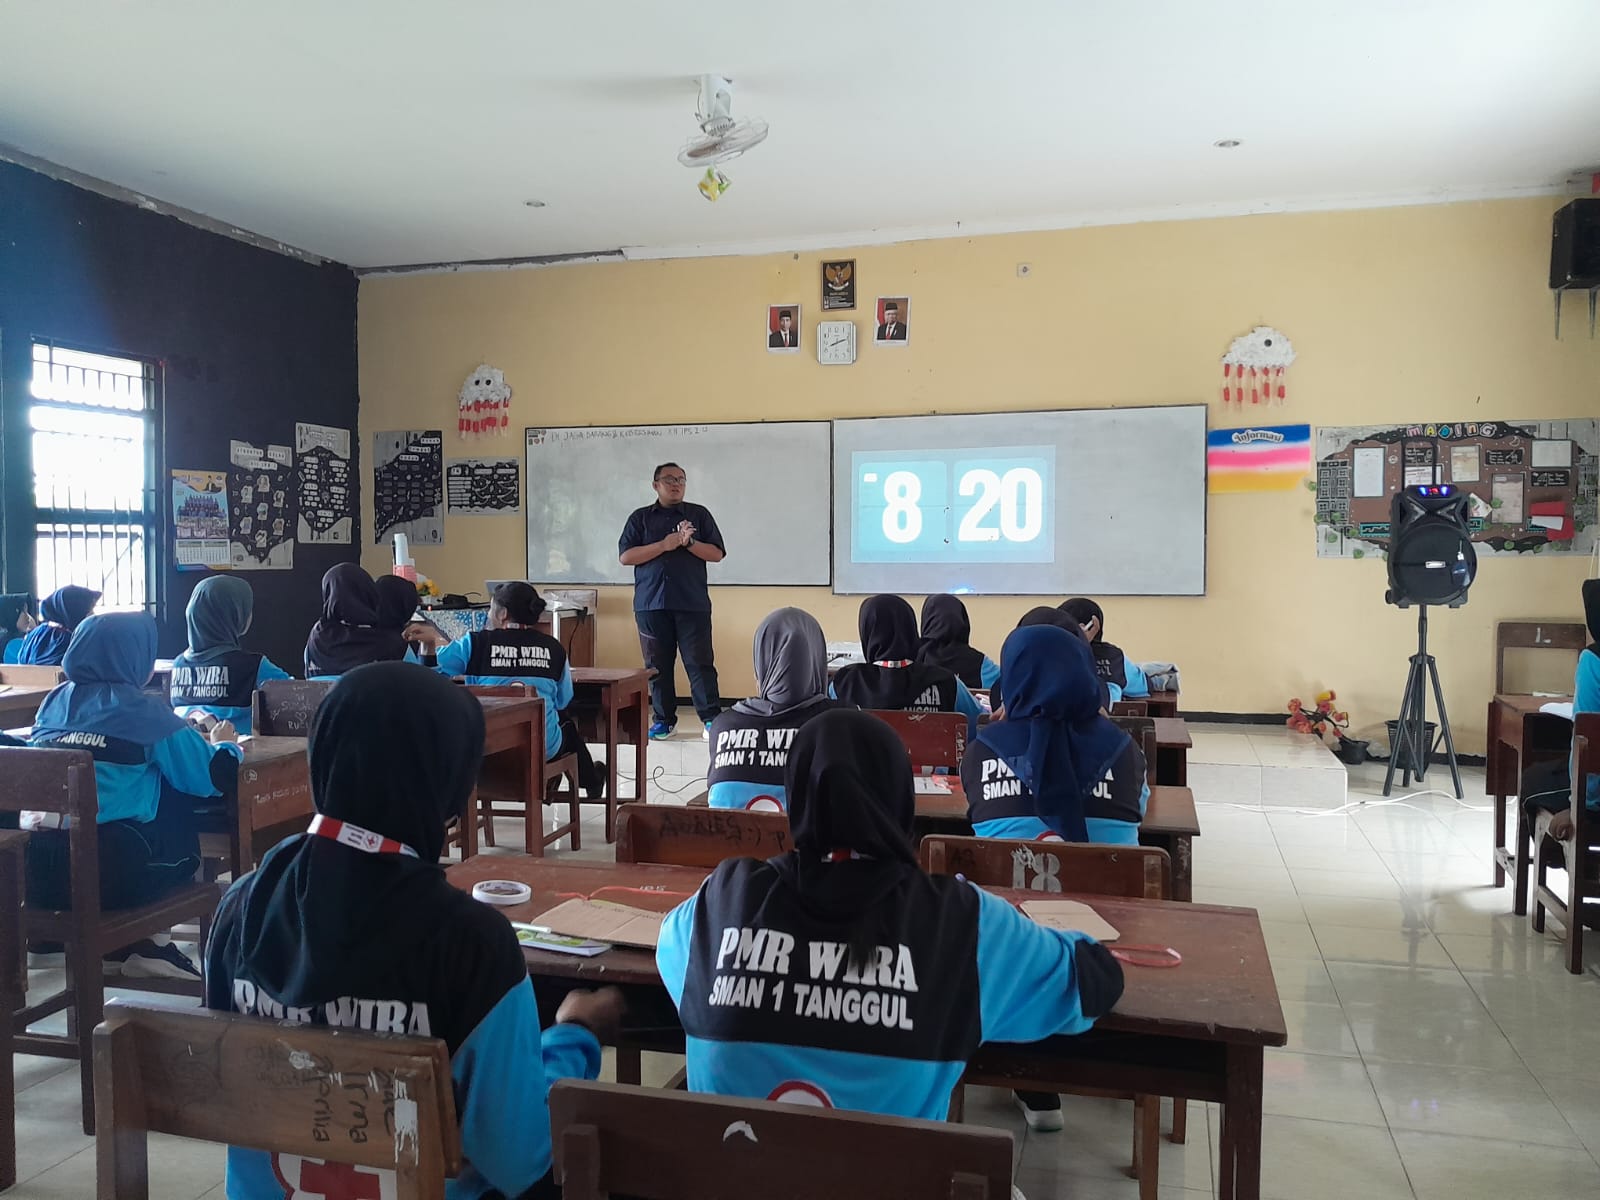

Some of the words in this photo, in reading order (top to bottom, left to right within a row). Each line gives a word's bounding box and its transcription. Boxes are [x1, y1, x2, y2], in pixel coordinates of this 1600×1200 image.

[958, 467, 1042, 542] 20
[490, 645, 518, 659] PMR
[520, 646, 551, 660] WIRA
[491, 658, 512, 668] SMAN
[512, 659, 517, 667] 1
[518, 658, 550, 669] TANGGUL
[195, 666, 230, 685] WIRA
[193, 686, 229, 698] TANGGUL
[716, 728, 759, 753] PMR
[766, 728, 799, 750] WI
[715, 750, 745, 769] SMAN
[748, 750, 755, 766] 1
[759, 750, 788, 767] TAN
[983, 779, 1022, 800] SMAN
[716, 927, 795, 975] PMR
[708, 976, 765, 1009] SMAN
[771, 980, 785, 1012] 1
[794, 983, 913, 1030] TANGGUL
[325, 995, 432, 1037] WIRA
